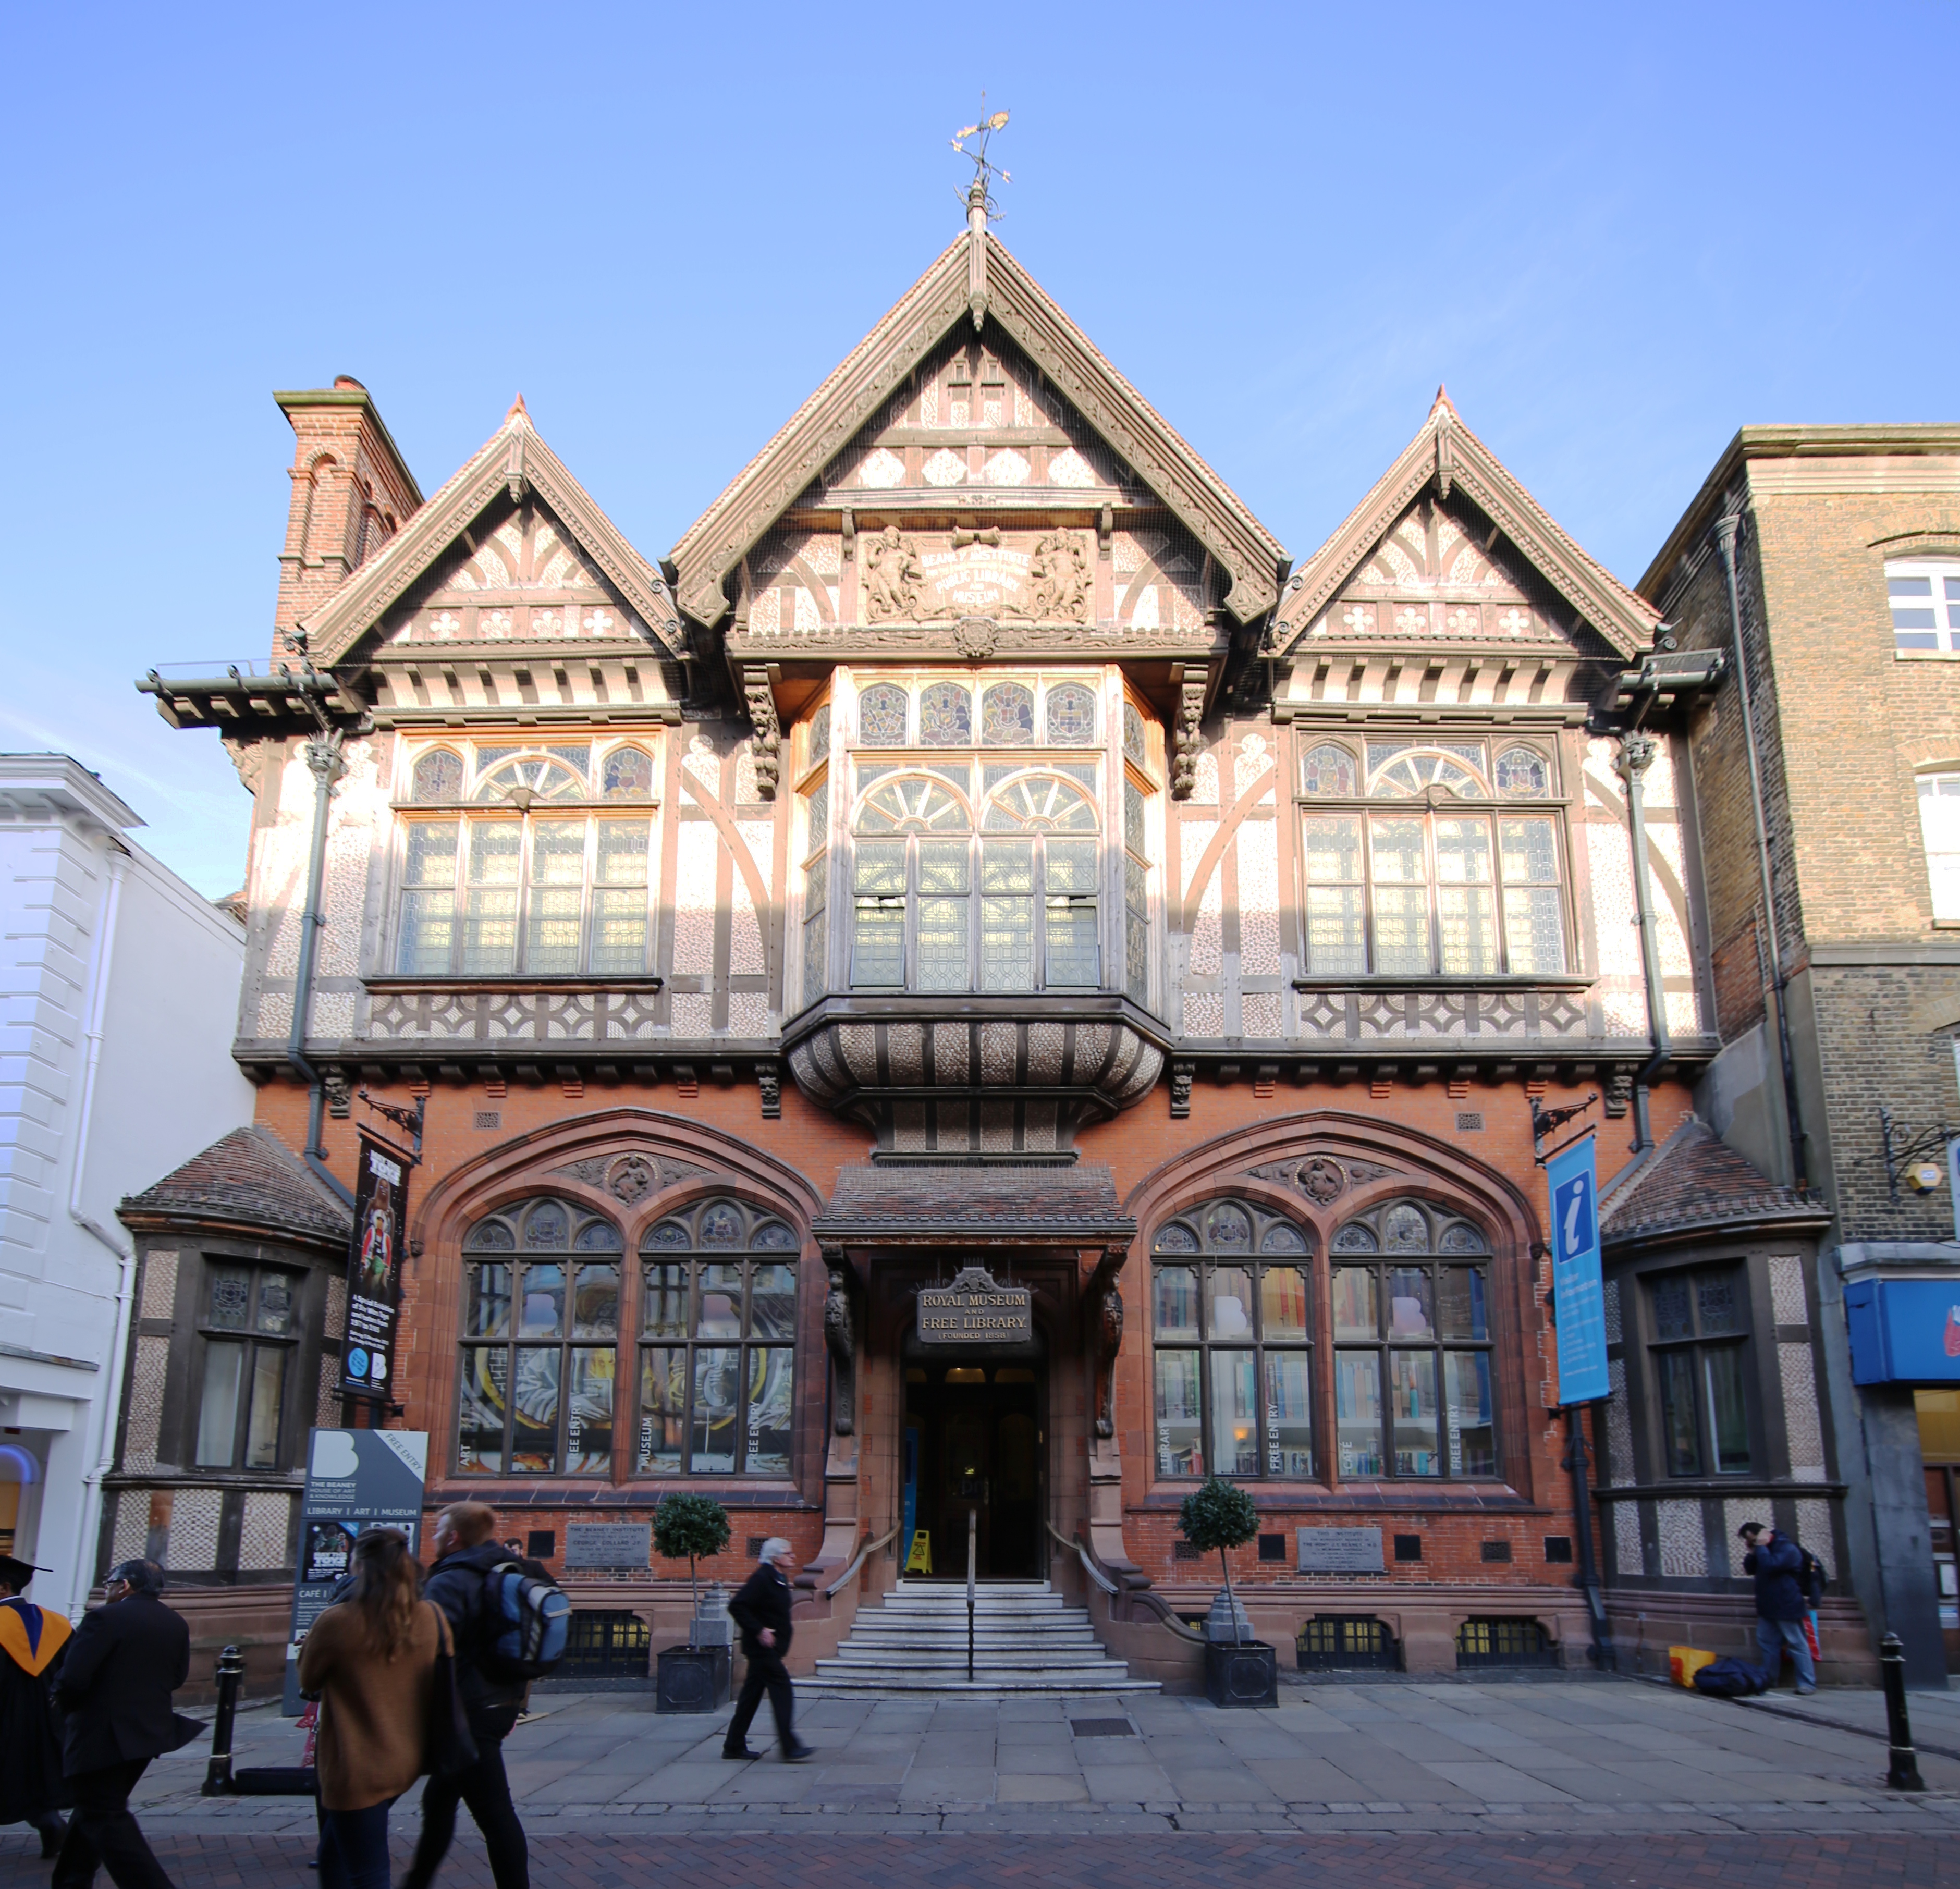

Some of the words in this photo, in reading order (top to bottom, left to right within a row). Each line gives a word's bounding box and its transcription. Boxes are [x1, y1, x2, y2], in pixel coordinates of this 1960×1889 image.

[921, 550, 967, 567] BEANEY
[970, 549, 1032, 567] INSTITUTE
[935, 570, 971, 594] PUBLIC
[974, 569, 1020, 593] LIBRARY
[952, 588, 999, 604] MUSEUM
[370, 1157, 401, 1182] TOYS
[923, 1295, 965, 1307] ROYAL
[969, 1294, 1025, 1306] MUSEUM
[922, 1318, 958, 1329] FREE
[963, 1317, 1027, 1329] LIBRARY.
[570, 1401, 582, 1437] ENTRY
[749, 1401, 761, 1437] ENTRY
[1267, 1402, 1279, 1439] ENTRY
[1448, 1403, 1461, 1440] ENTRY
[385, 1433, 403, 1451] FREE
[400, 1449, 423, 1470] ENTRY
[459, 1444, 471, 1467] ART
[568, 1439, 580, 1466] FREE
[640, 1417, 652, 1467] MUSEUM
[748, 1439, 760, 1466] FREE
[1159, 1422, 1170, 1469] LIBRARY
[1268, 1441, 1280, 1469] FREE
[1339, 1440, 1353, 1470] CAFÉ
[1449, 1442, 1462, 1470] FREE
[298, 1589, 321, 1598] CAFÉ
